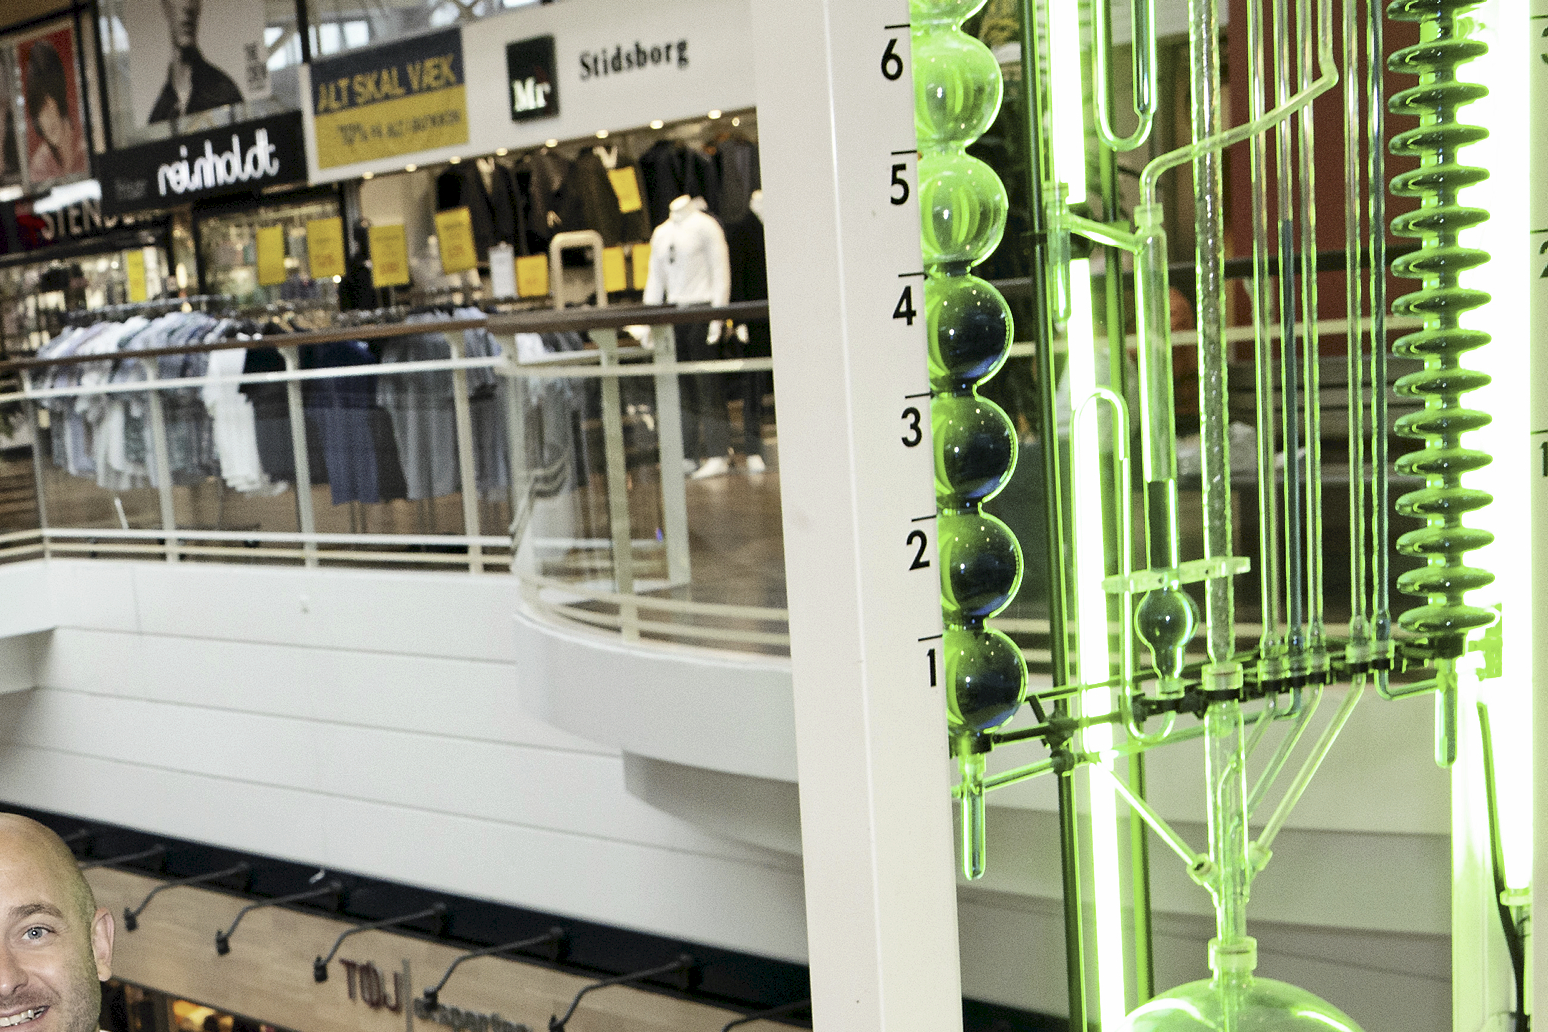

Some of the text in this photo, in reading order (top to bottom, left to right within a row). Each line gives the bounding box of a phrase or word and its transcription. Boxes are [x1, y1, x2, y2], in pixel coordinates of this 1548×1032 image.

[578, 39, 690, 80] Stidsborg
[881, 38, 904, 81] 6
[317, 53, 456, 112] ALT SKAL VÆK
[513, 76, 551, 112] Mr
[157, 127, 280, 197] reinholdt
[890, 163, 910, 206] 5
[892, 285, 917, 326] 4
[901, 407, 922, 448] 3
[906, 529, 930, 571] 2
[927, 648, 938, 687] 1
